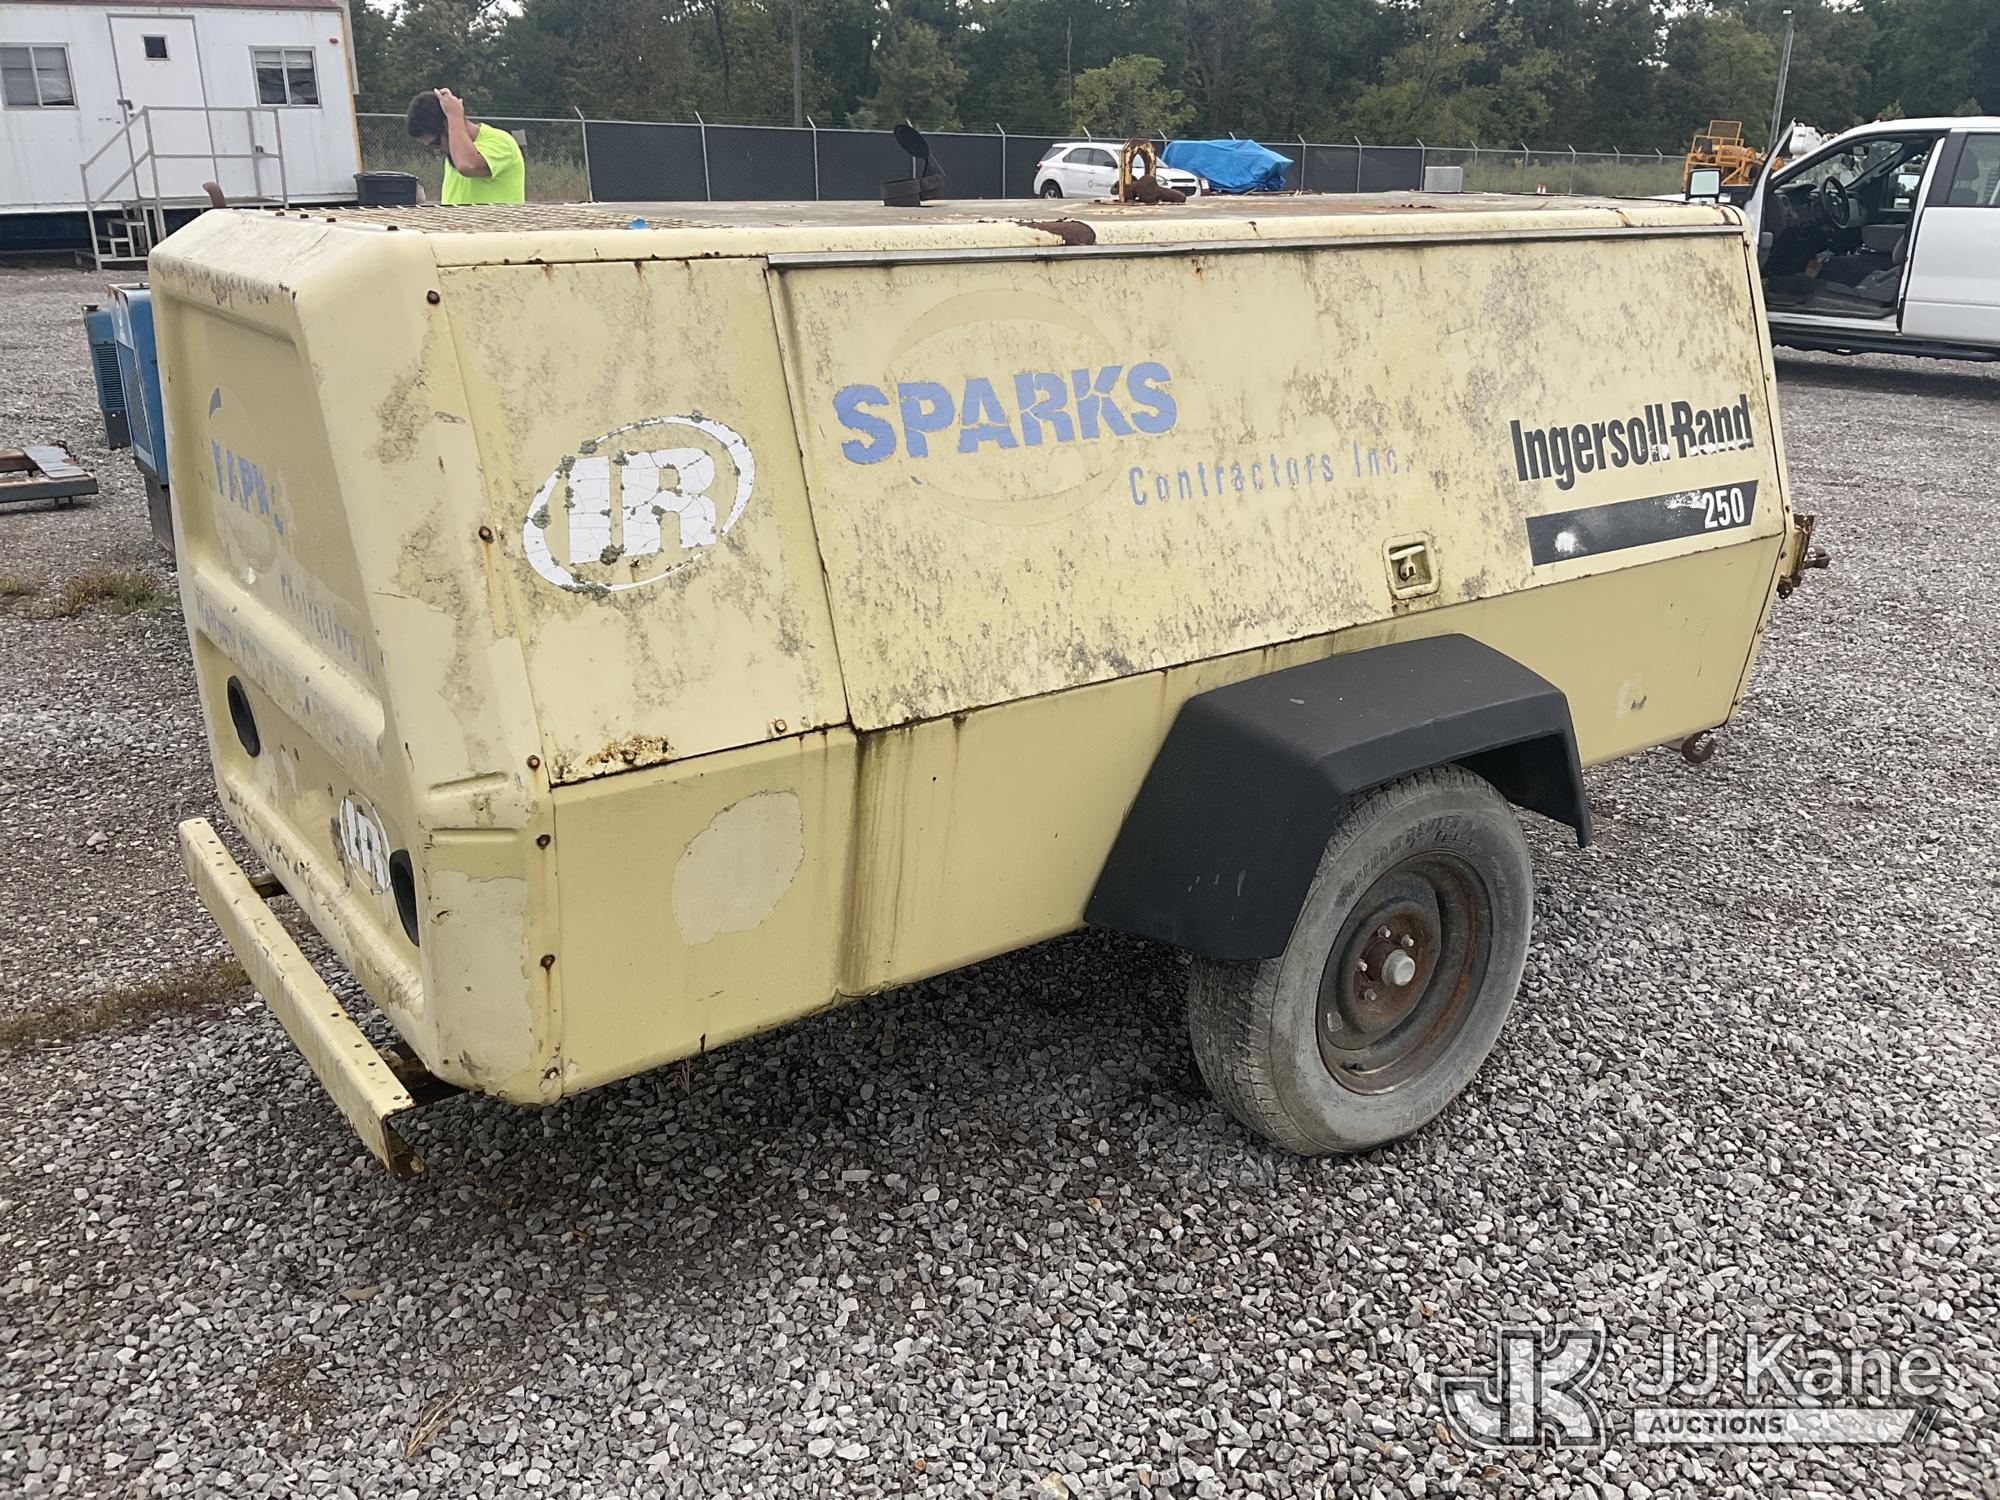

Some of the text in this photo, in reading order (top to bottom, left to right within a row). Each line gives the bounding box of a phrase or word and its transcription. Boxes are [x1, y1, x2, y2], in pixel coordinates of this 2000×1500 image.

[832, 361, 1178, 465] SPARKS
[566, 447, 717, 565] IR
[1129, 439, 1411, 506] Contractors Inc.
[1703, 487, 1745, 529] 250
